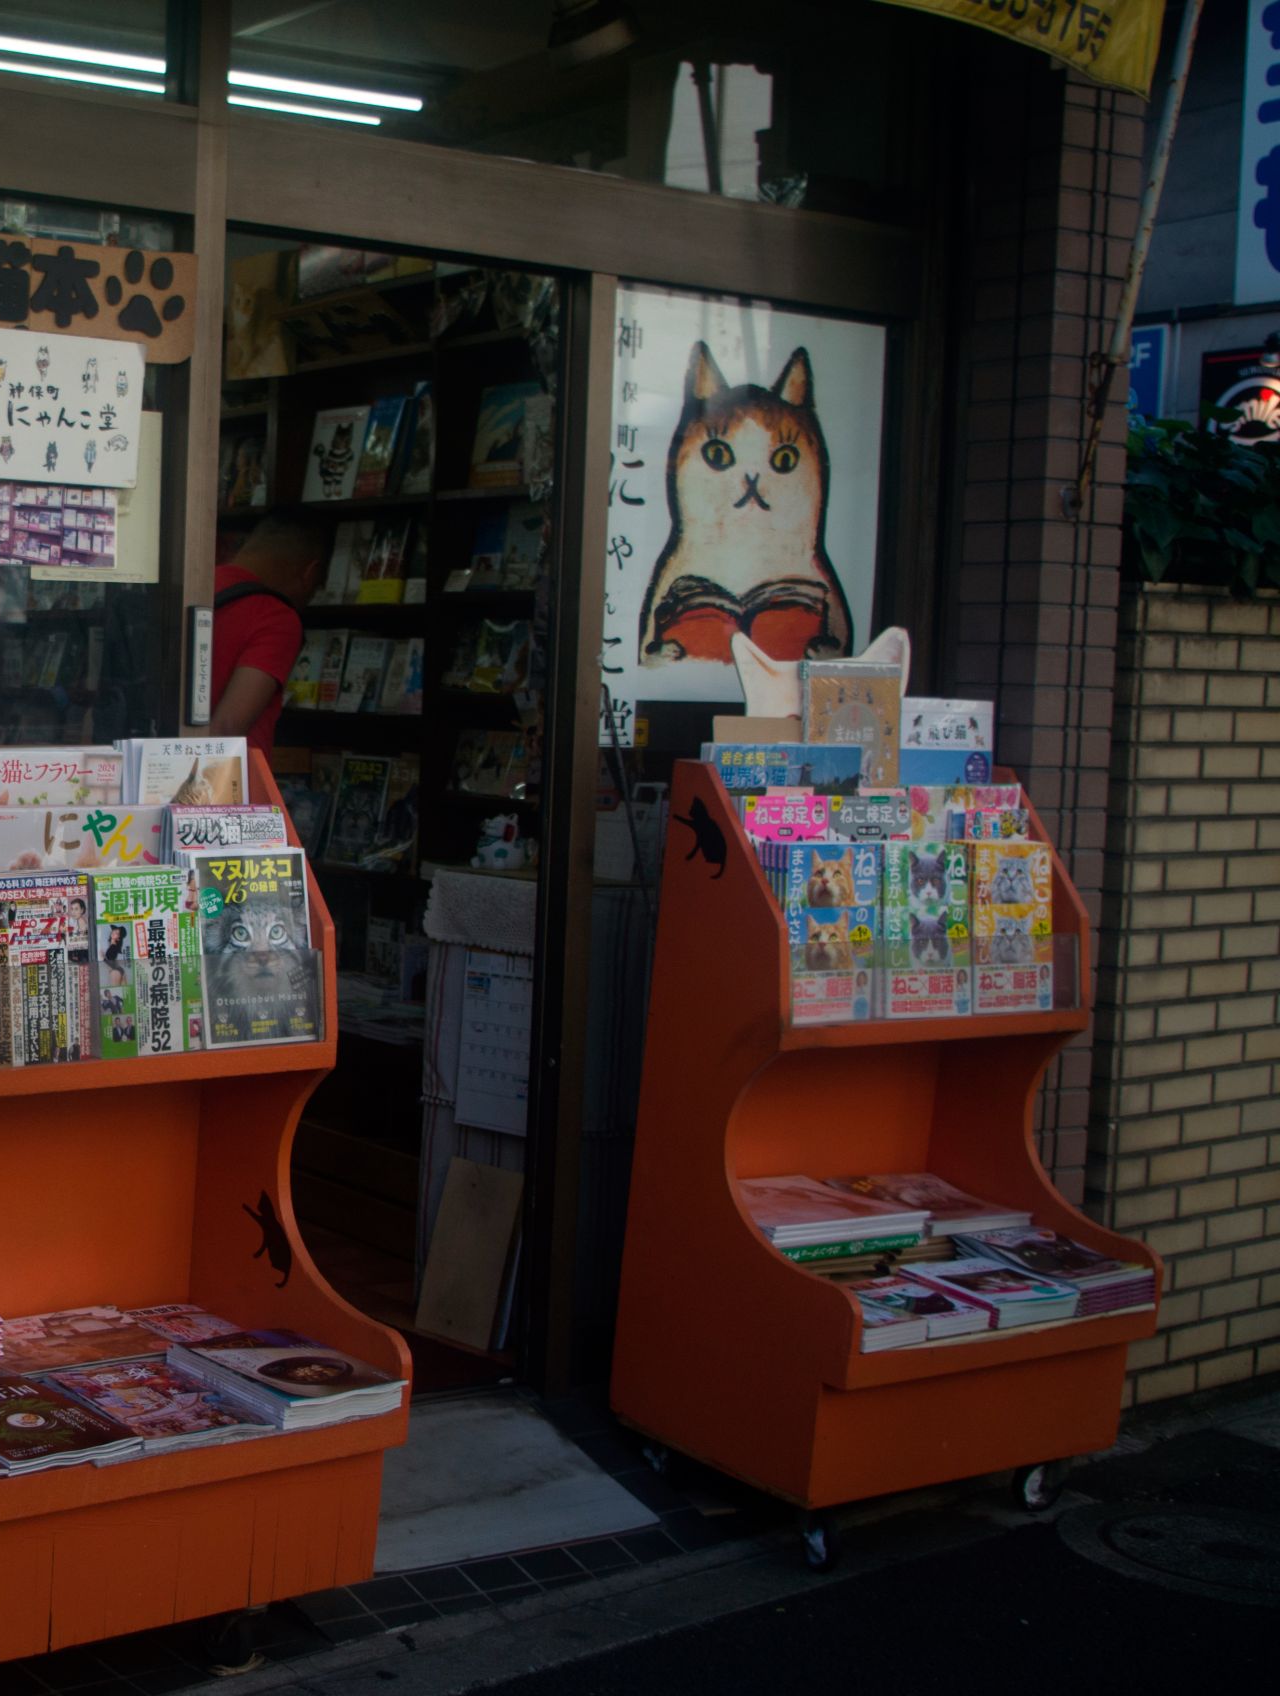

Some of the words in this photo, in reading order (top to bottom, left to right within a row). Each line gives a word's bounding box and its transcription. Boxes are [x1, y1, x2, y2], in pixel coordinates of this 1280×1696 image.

[9, 383, 60, 400] 神保町
[7, 401, 119, 430] にゃんこ堂
[162, 743, 225, 757] 天然ねこ生活
[177, 815, 242, 846] ワル猫
[208, 858, 292, 881] マヌルネコ
[1032, 849, 1051, 919] ねこの
[947, 848, 968, 922] ねこの
[147, 919, 172, 1053] 最強の病院52
